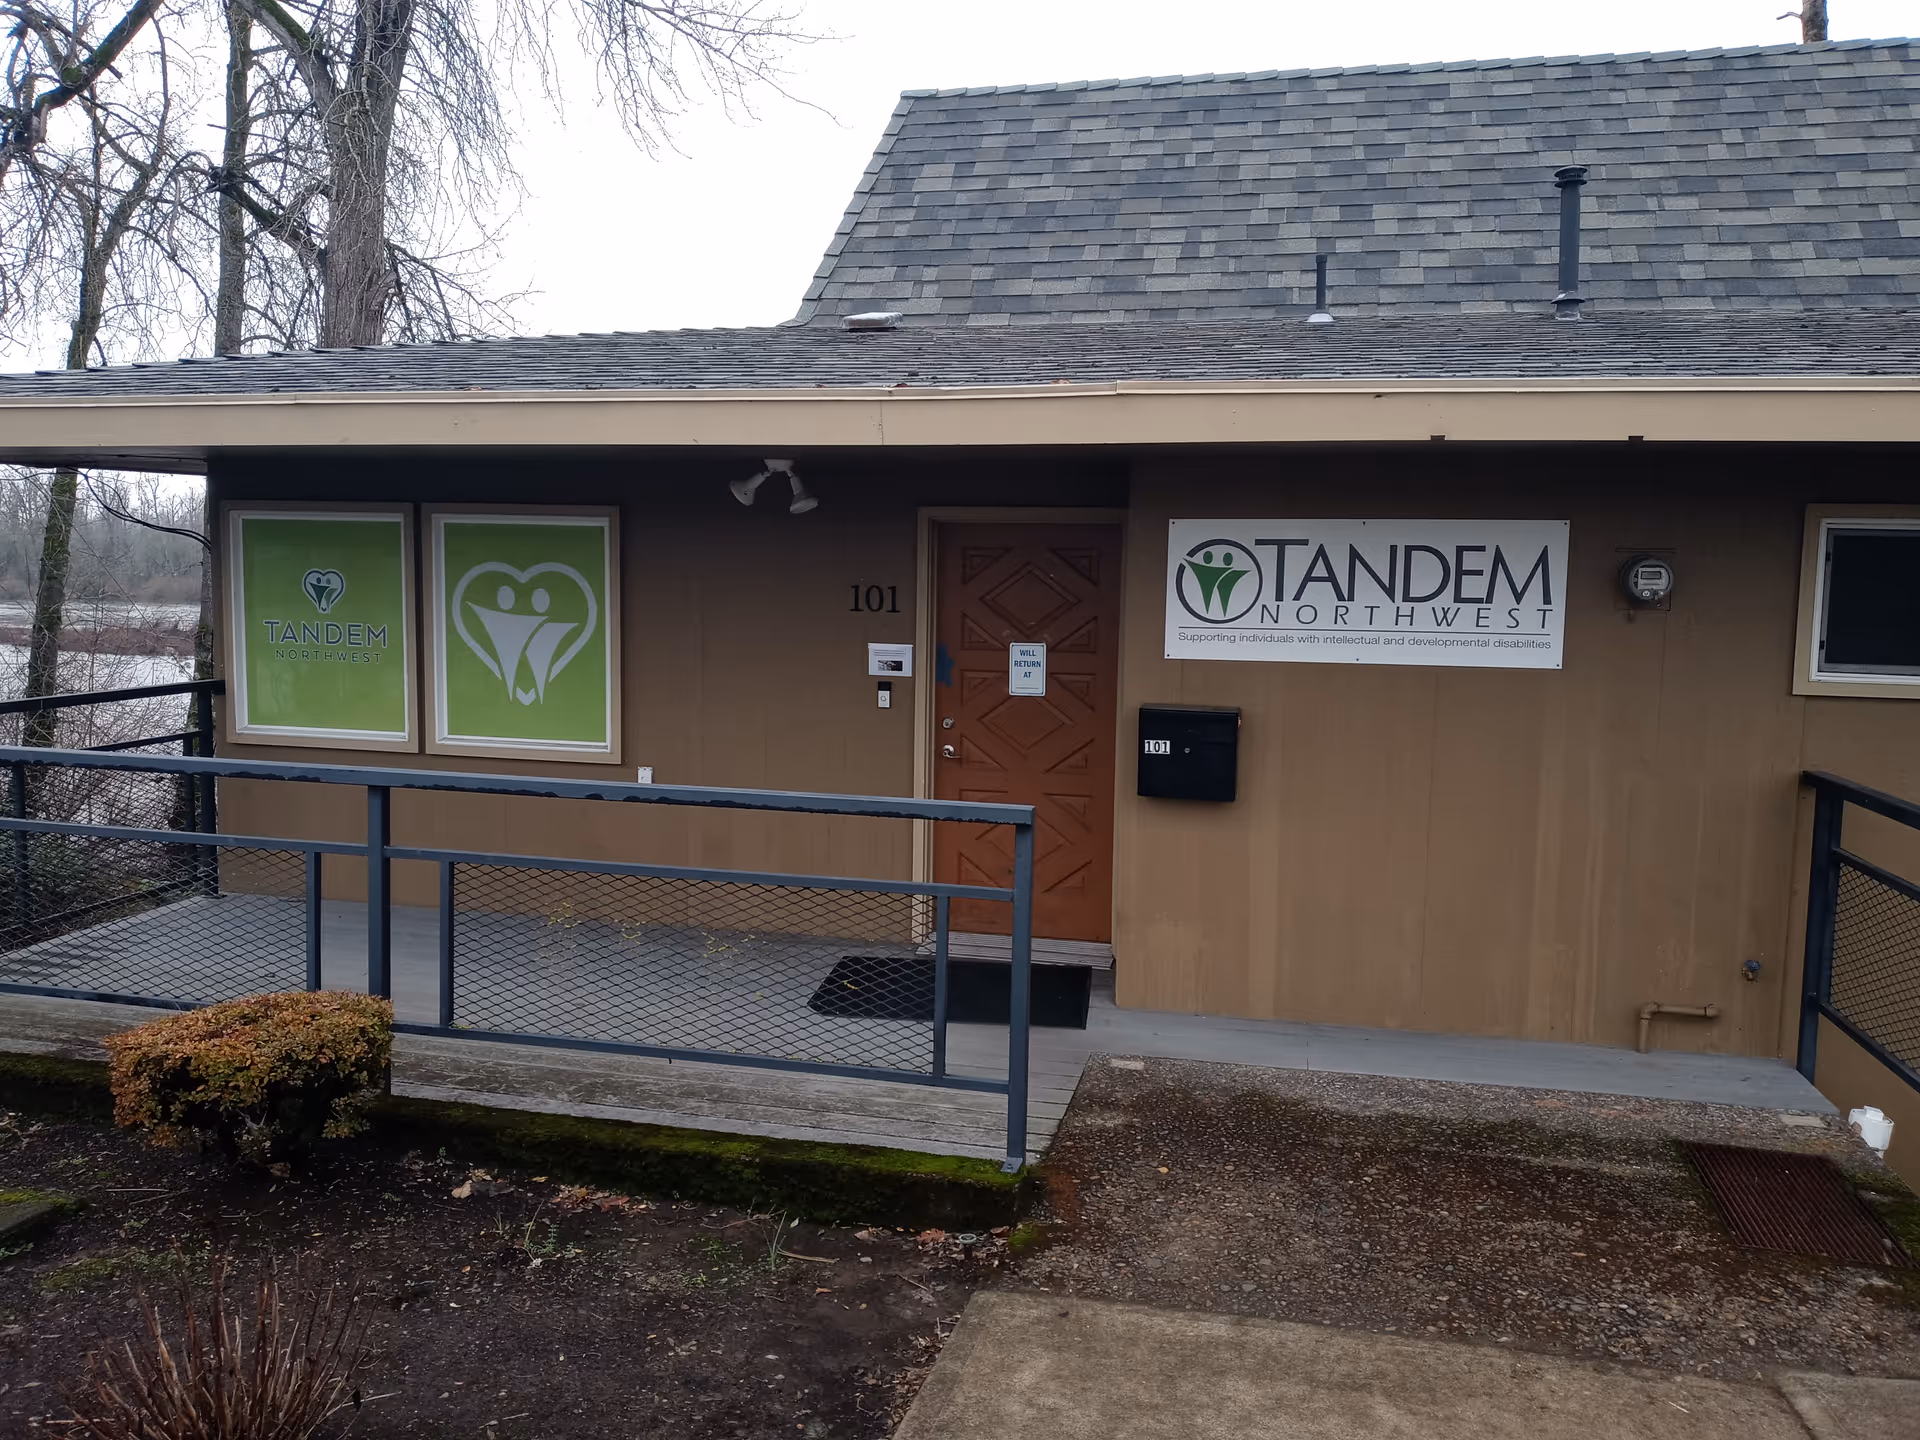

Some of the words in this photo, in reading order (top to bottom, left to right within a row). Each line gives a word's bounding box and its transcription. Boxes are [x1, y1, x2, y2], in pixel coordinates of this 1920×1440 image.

[1254, 538, 1553, 606] TANDEM
[849, 584, 901, 613] 101
[1260, 604, 1553, 630] NORTHWEST
[263, 619, 388, 648] TANDEM
[1178, 632, 1237, 644] Supporting
[1239, 633, 1294, 643] individuals
[1297, 634, 1320, 644] with
[1323, 635, 1381, 645] intellectual
[1383, 636, 1405, 646] and
[1408, 637, 1490, 649] developmental
[1493, 638, 1552, 650] disabilities
[275, 649, 382, 663] NORTHWEST
[1019, 649, 1037, 657] WILL
[1013, 660, 1042, 668] RETURN
[1022, 671, 1032, 679] AT
[1145, 740, 1169, 754] 101
